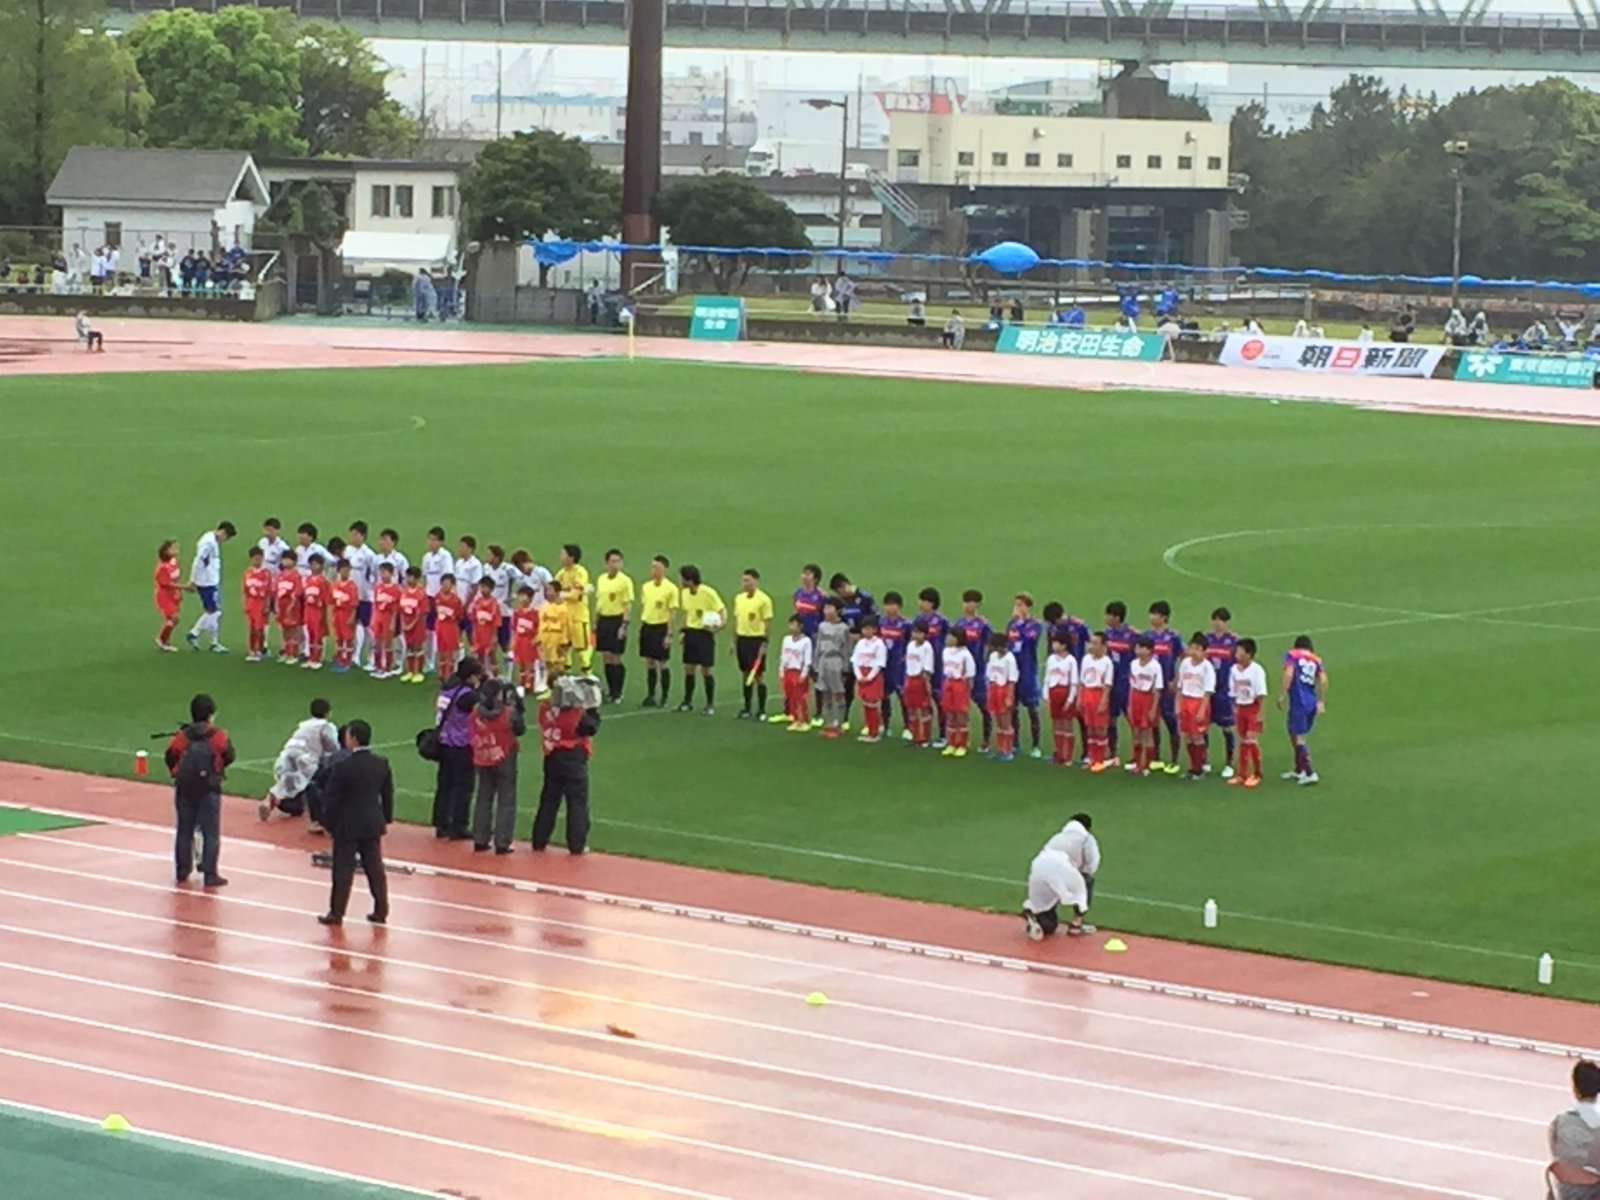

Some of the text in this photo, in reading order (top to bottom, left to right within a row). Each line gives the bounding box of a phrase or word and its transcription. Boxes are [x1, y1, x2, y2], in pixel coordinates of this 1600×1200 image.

[1015, 329, 1145, 358] 明治安田生命
[1298, 344, 1428, 369] 朝日新聞
